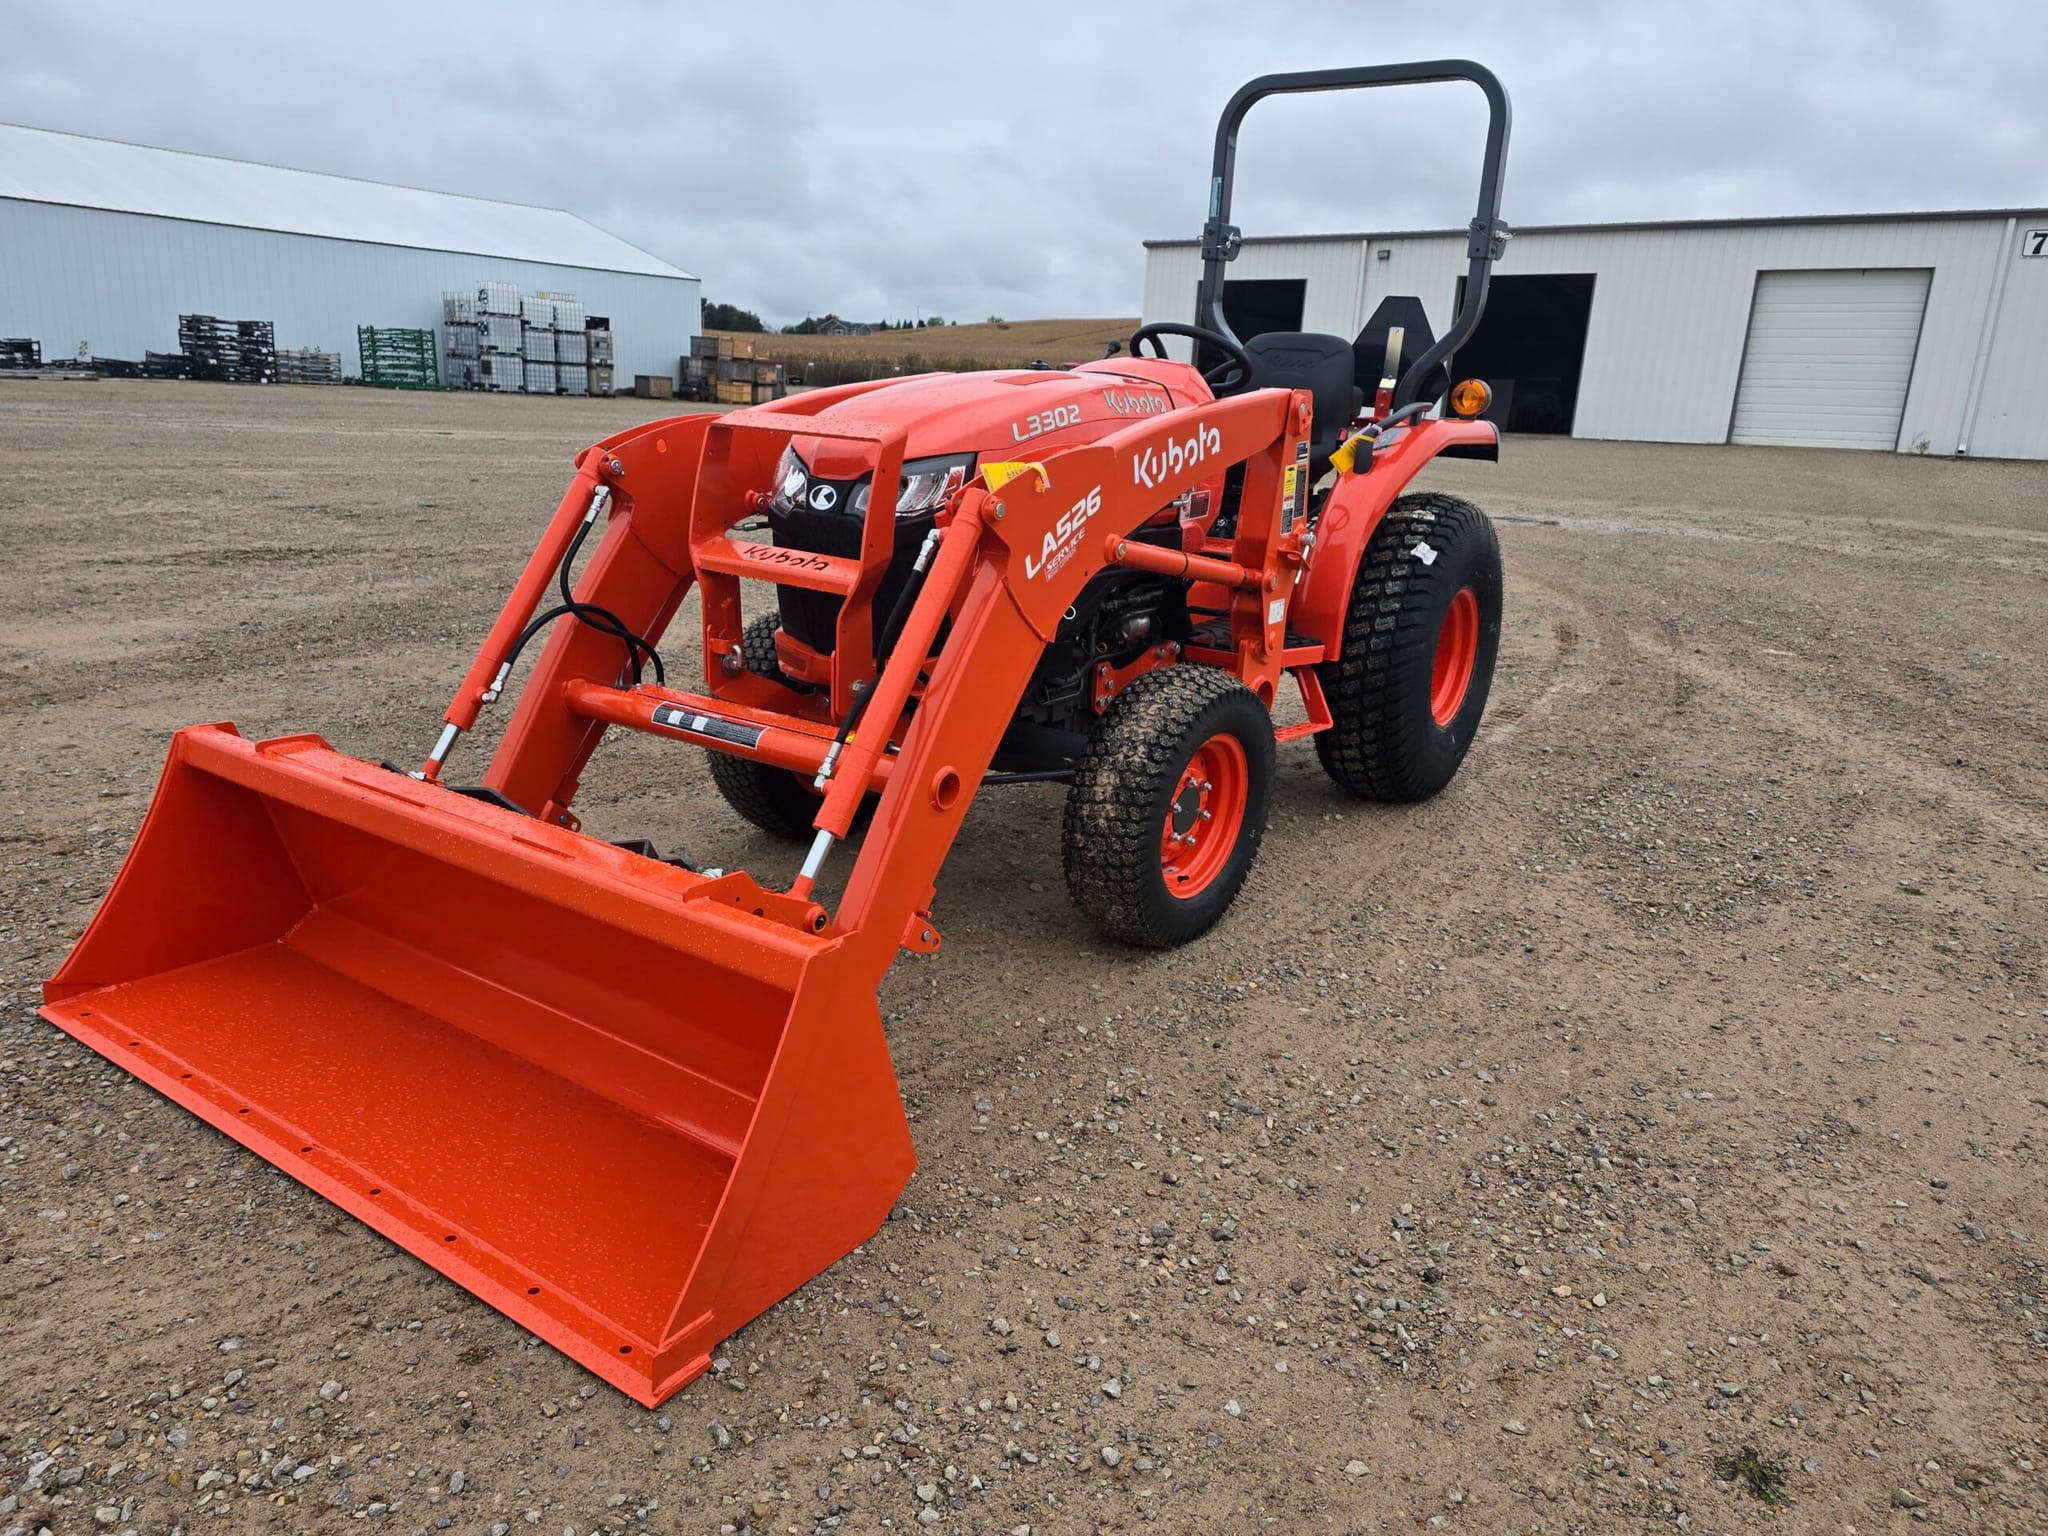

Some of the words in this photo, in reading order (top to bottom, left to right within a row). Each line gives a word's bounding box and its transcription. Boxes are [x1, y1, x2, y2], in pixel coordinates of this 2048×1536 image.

[1103, 390, 1167, 414] Kubota
[1012, 404, 1082, 442] L3302
[1133, 422, 1221, 489] Kubota
[1025, 485, 1102, 580] LA526
[744, 546, 829, 571] Kubota
